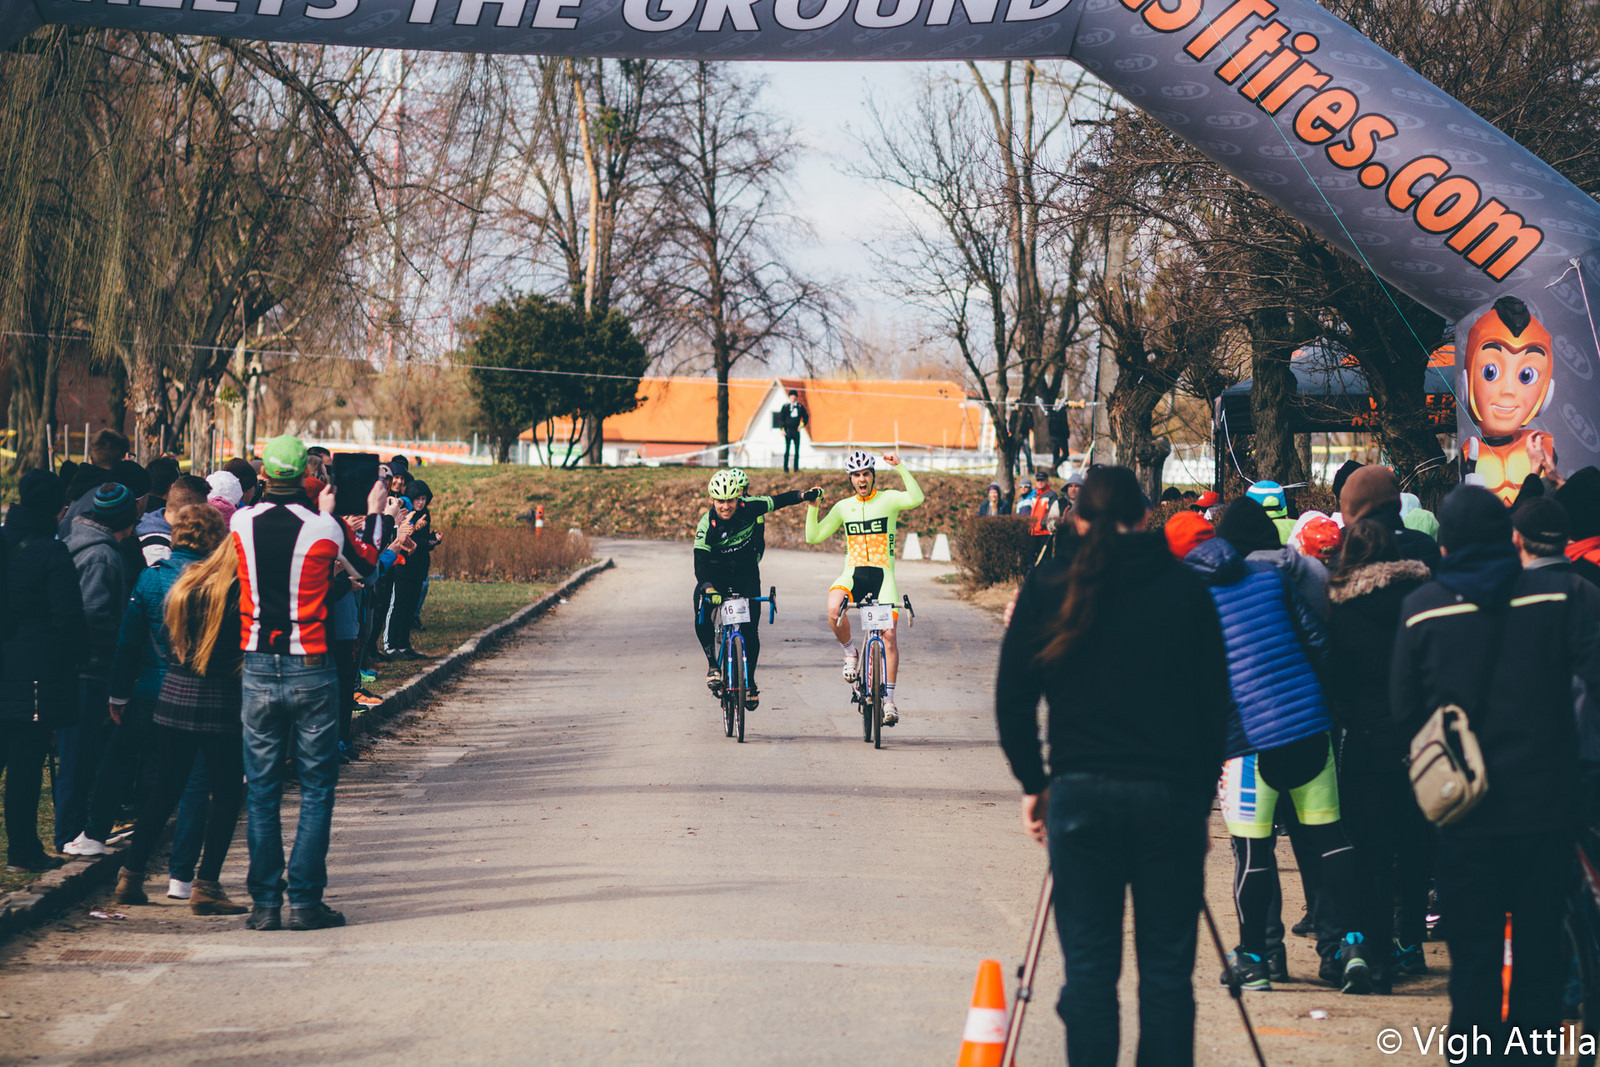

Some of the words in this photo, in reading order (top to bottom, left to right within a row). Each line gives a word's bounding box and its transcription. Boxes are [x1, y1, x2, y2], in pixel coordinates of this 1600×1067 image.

[1329, 51, 1374, 66] CST
[1160, 84, 1196, 97] CST
[1205, 115, 1244, 126] CST
[1119, 0, 1545, 282] Ttires.com
[1540, 217, 1589, 233] CST
[1554, 335, 1587, 369] CST
[1562, 403, 1596, 441] CST
[724, 605, 734, 615] 16
[867, 611, 873, 621] 9
